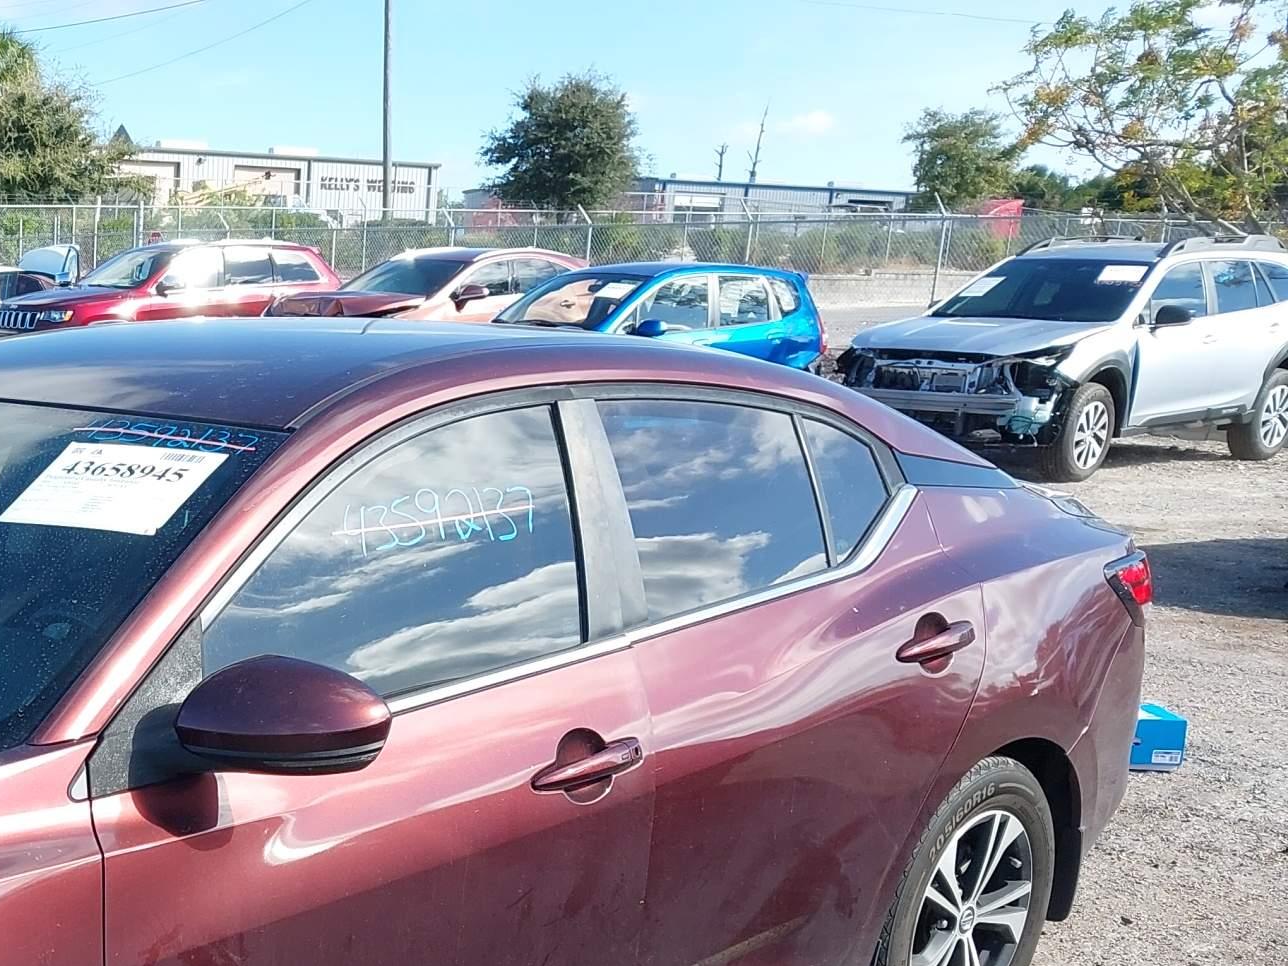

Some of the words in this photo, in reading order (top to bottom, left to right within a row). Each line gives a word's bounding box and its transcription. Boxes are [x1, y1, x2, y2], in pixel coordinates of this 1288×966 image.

[86, 419, 259, 454] 43592137
[62, 460, 190, 482] 43658945
[343, 486, 534, 557] 43592137
[928, 782, 995, 862] 205/60R16
